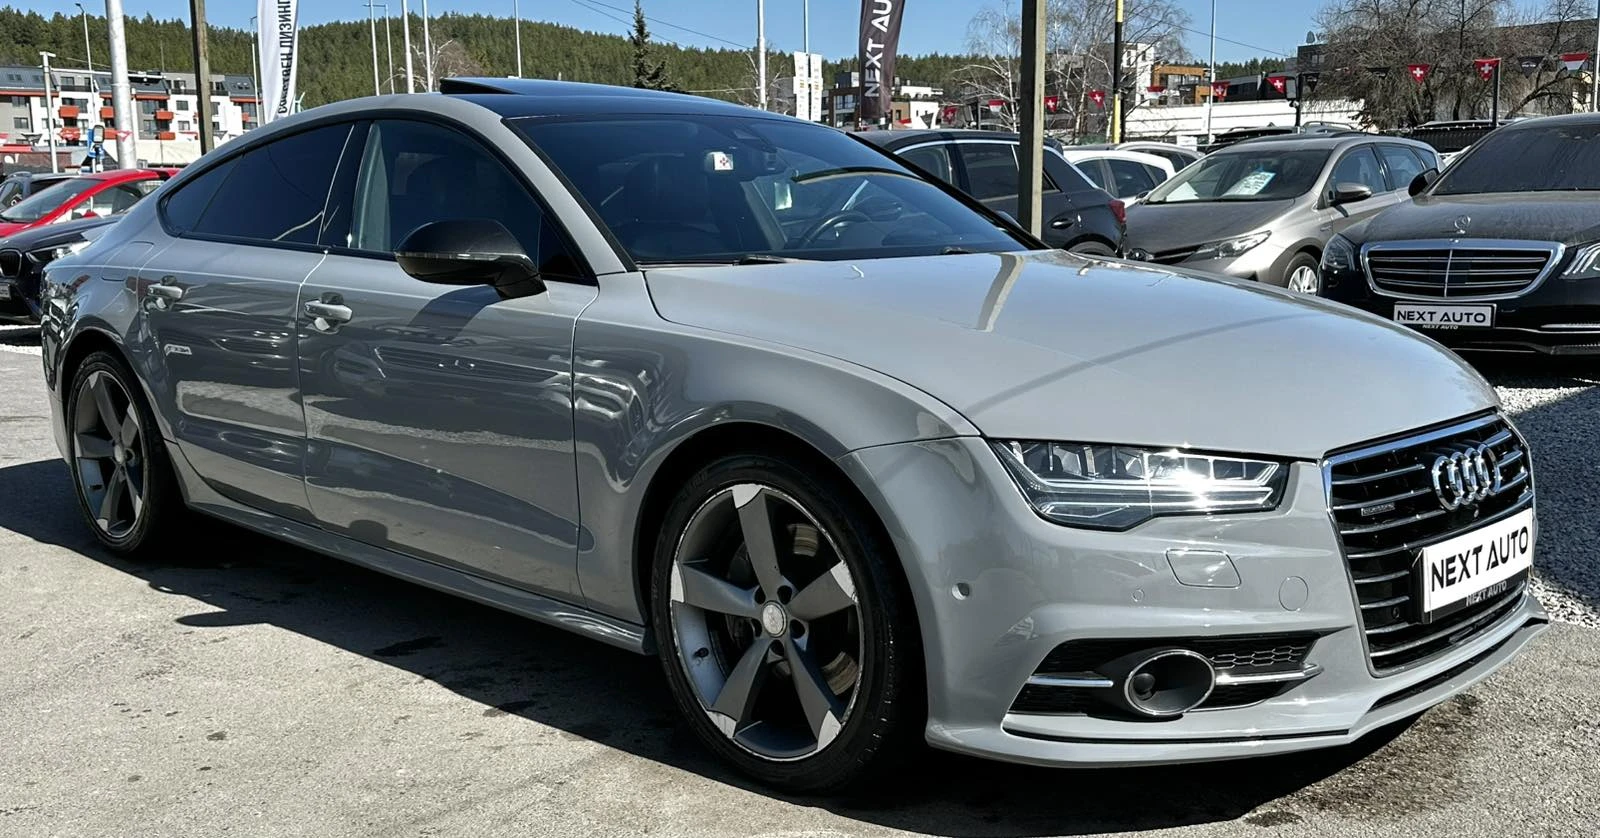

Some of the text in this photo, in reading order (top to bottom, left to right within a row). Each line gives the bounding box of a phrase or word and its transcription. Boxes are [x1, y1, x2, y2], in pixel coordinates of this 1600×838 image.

[864, 38, 885, 97] NEXT
[1397, 310, 1486, 323] NEXT AUTO
[1431, 526, 1529, 592] NEXT AUTO
[1465, 580, 1507, 607] NEXT AUTO
